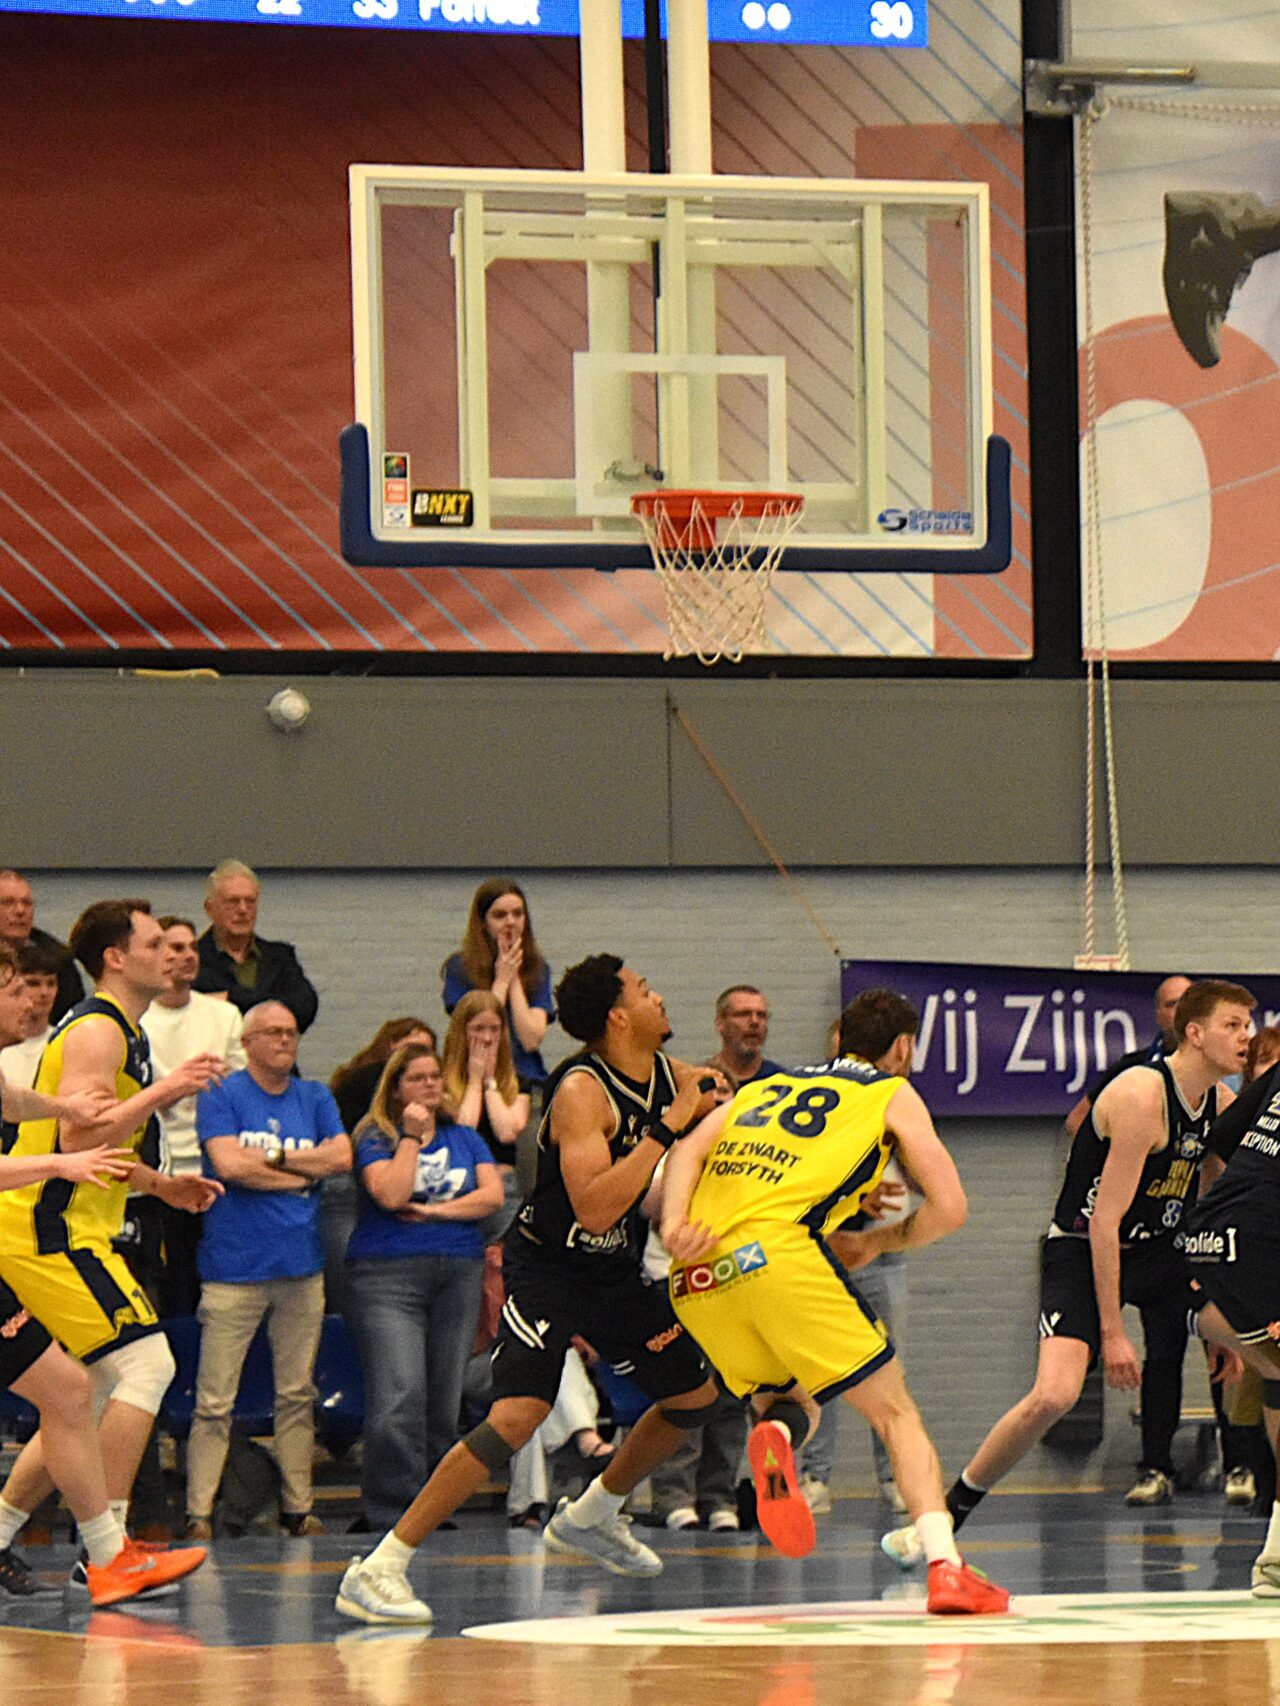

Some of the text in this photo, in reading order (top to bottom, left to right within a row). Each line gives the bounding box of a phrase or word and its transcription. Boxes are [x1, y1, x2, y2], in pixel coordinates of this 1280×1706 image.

[869, 1, 914, 39] 30
[414, 493, 470, 515] BNXT
[1003, 989, 1137, 1094] Zijn
[734, 1084, 841, 1138] 28
[707, 1159, 785, 1185] FORSYTH
[714, 1141, 802, 1169] DE ZWART
[672, 1242, 766, 1296] FOOX
